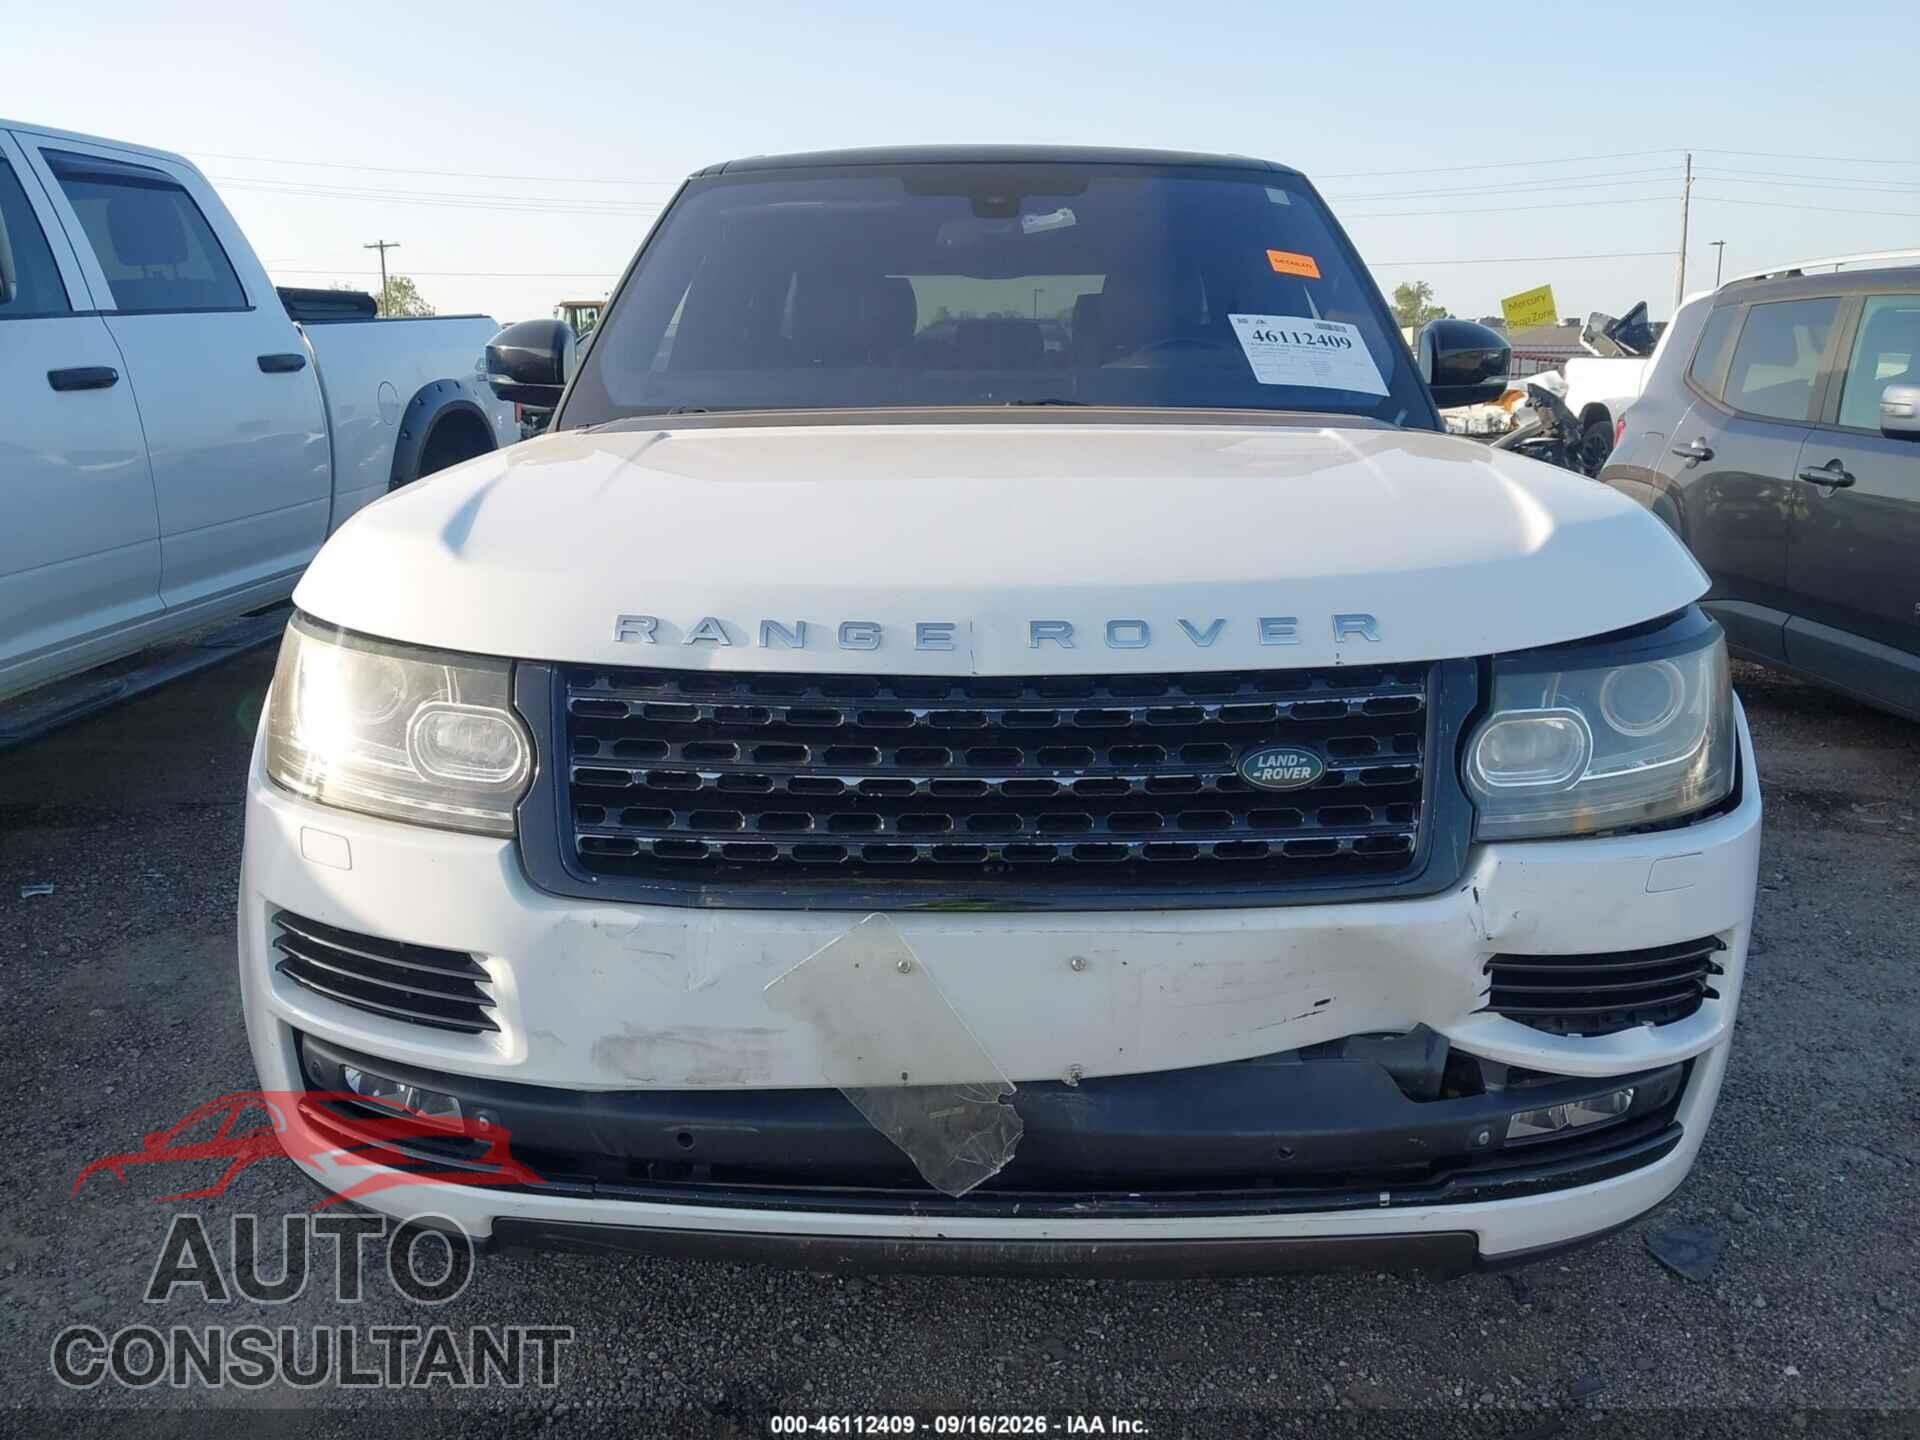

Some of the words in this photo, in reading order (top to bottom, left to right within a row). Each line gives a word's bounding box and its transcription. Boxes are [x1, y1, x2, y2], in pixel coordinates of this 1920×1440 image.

[1508, 295, 1546, 311] Mercury
[1252, 330, 1352, 350] 46112409
[612, 613, 956, 651] RANGE
[1028, 612, 1381, 649] ROVER
[1257, 754, 1298, 768] LAND
[1262, 767, 1312, 781] ROVER
